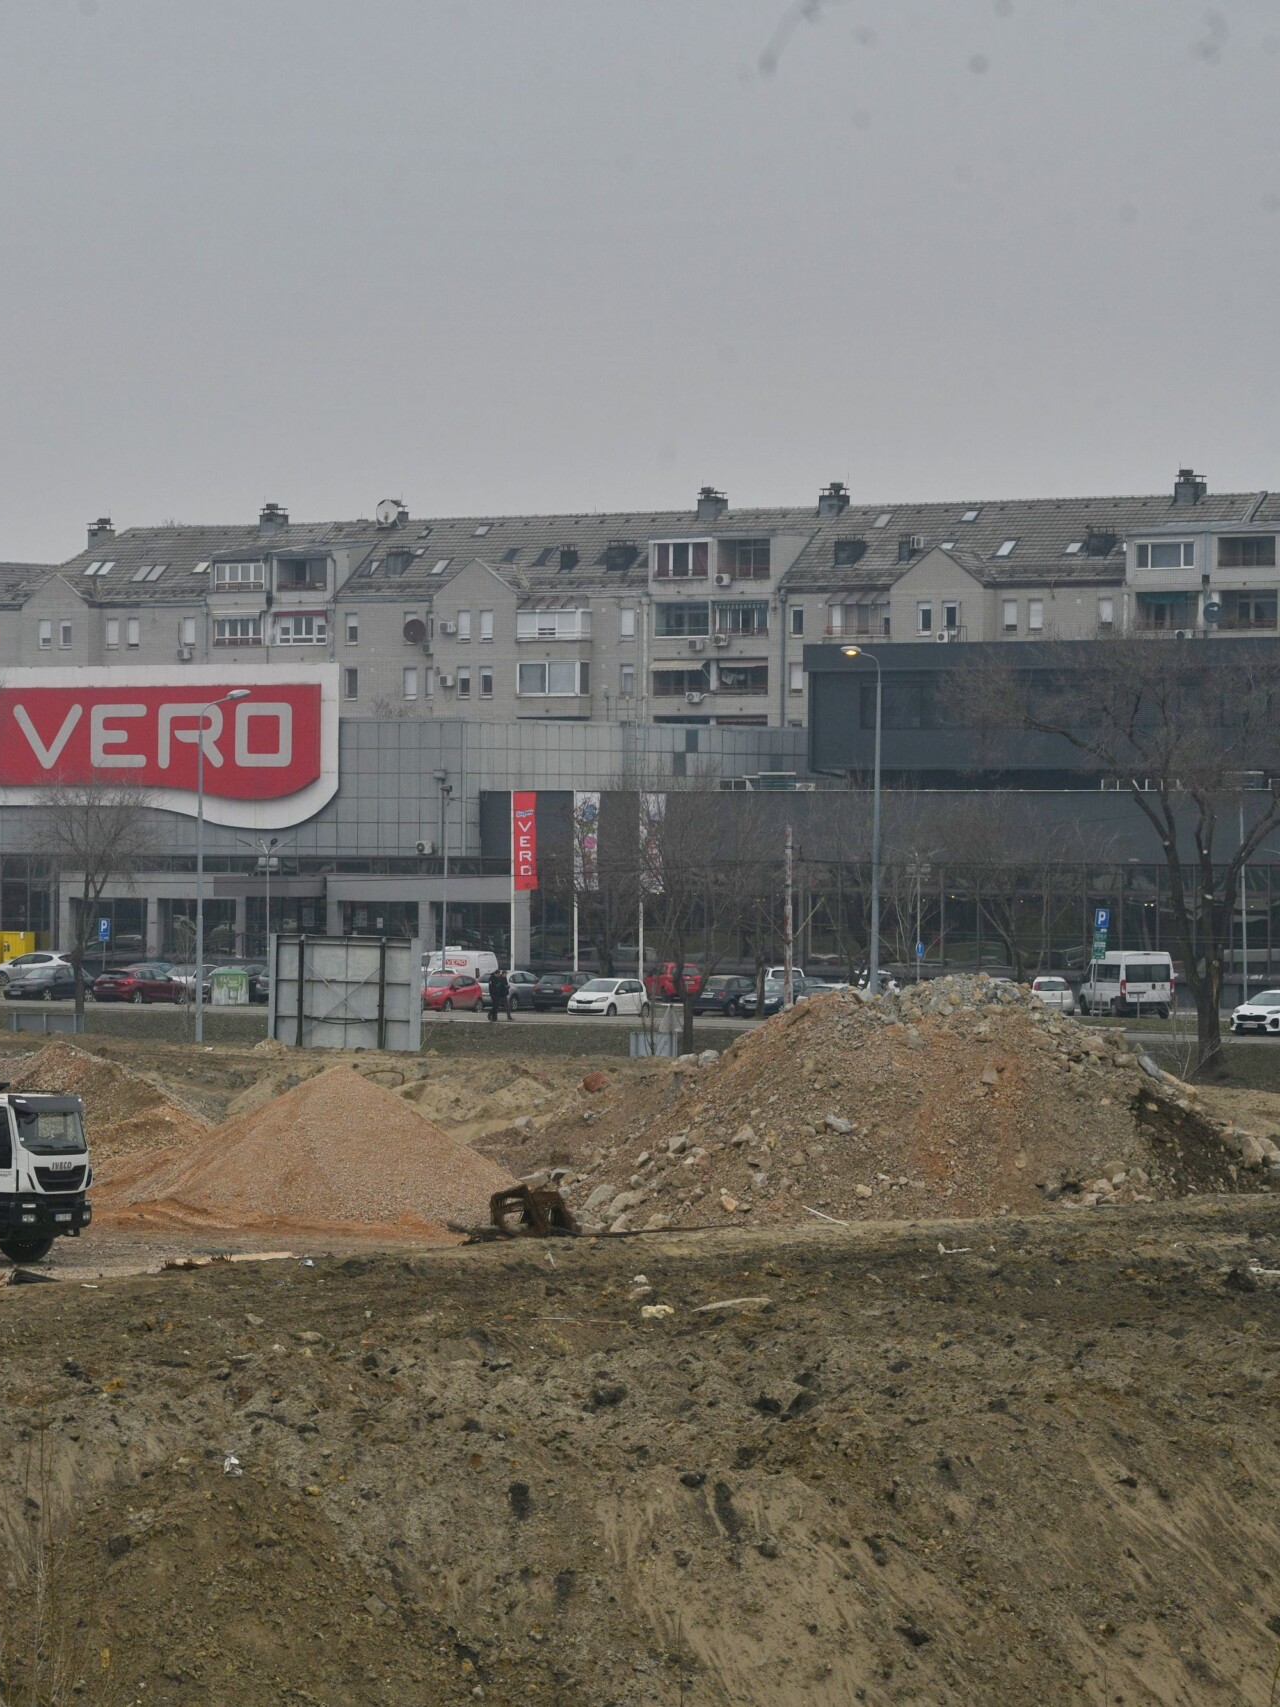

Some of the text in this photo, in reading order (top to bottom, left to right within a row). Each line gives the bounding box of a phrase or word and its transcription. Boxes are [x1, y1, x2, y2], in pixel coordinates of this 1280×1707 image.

[13, 702, 293, 769] VERO
[518, 821, 532, 876] VERO
[1098, 911, 1106, 925] P
[101, 920, 107, 932] P
[51, 1161, 73, 1170] IVECO
